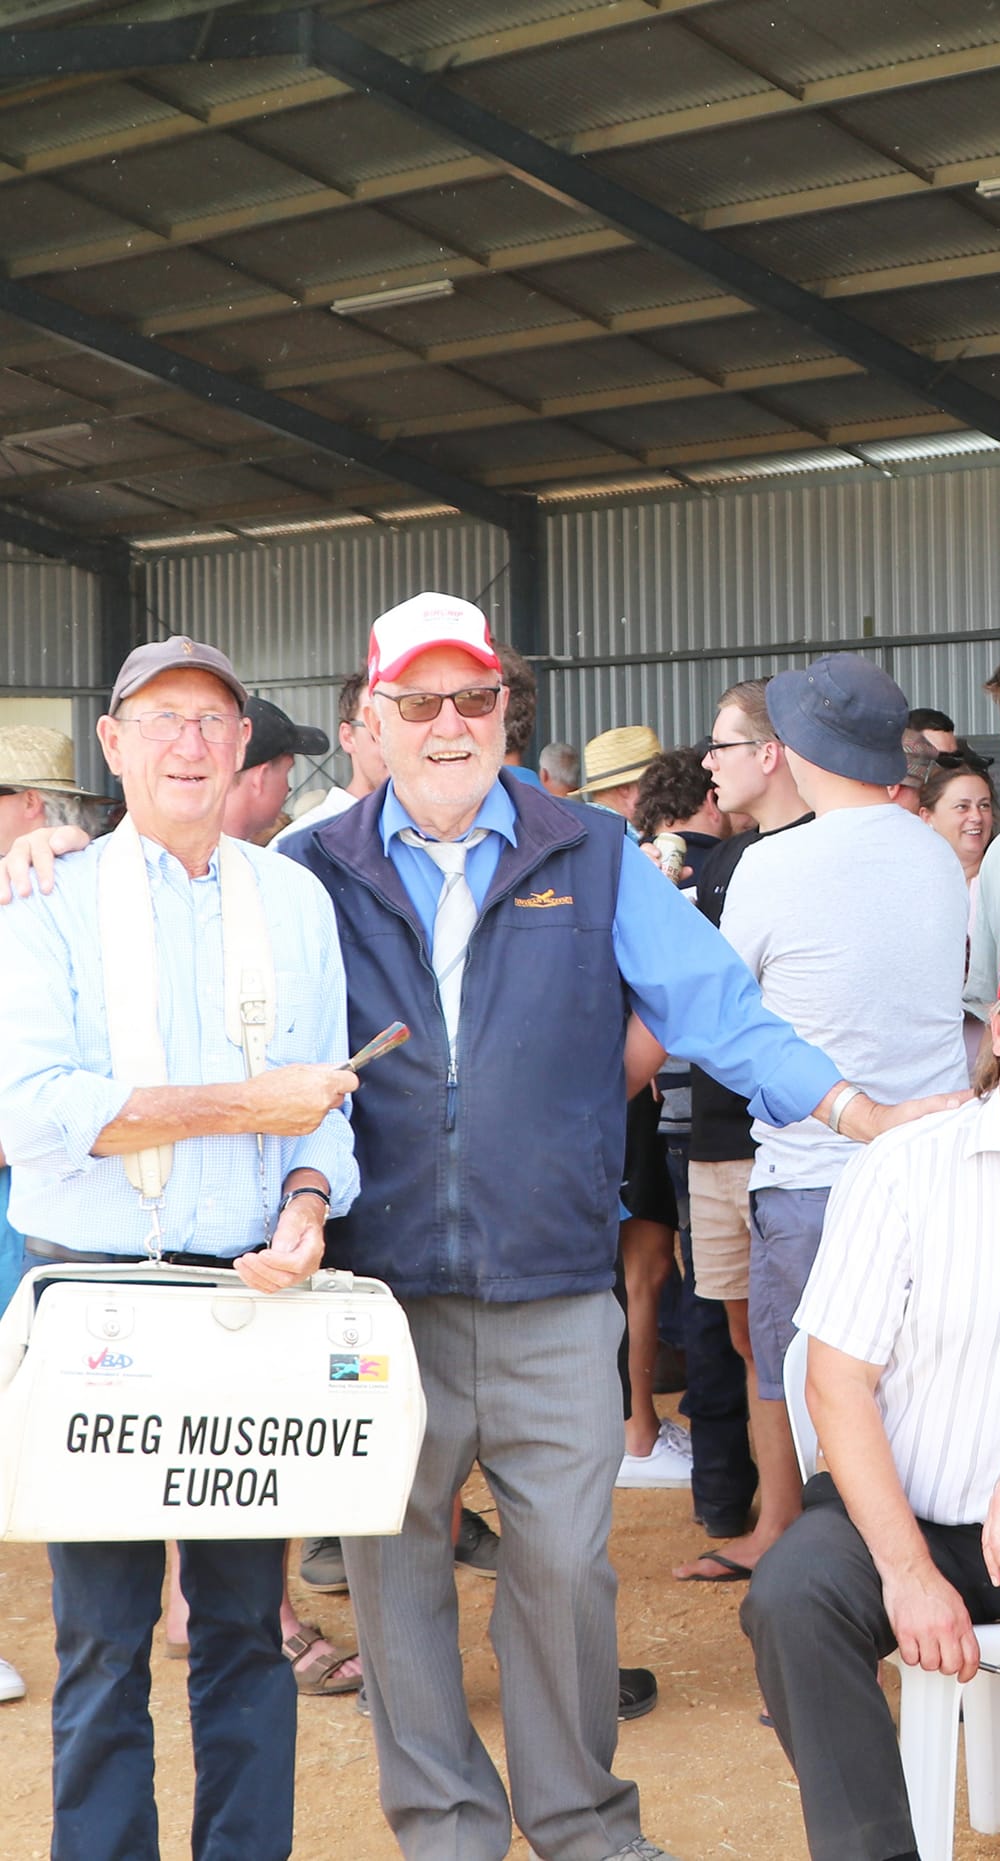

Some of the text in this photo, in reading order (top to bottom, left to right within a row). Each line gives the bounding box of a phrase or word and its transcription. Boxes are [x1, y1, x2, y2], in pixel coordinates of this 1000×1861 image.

[66, 1413, 374, 1458] GREG MUSGROVE
[162, 1467, 279, 1507] EUROA
